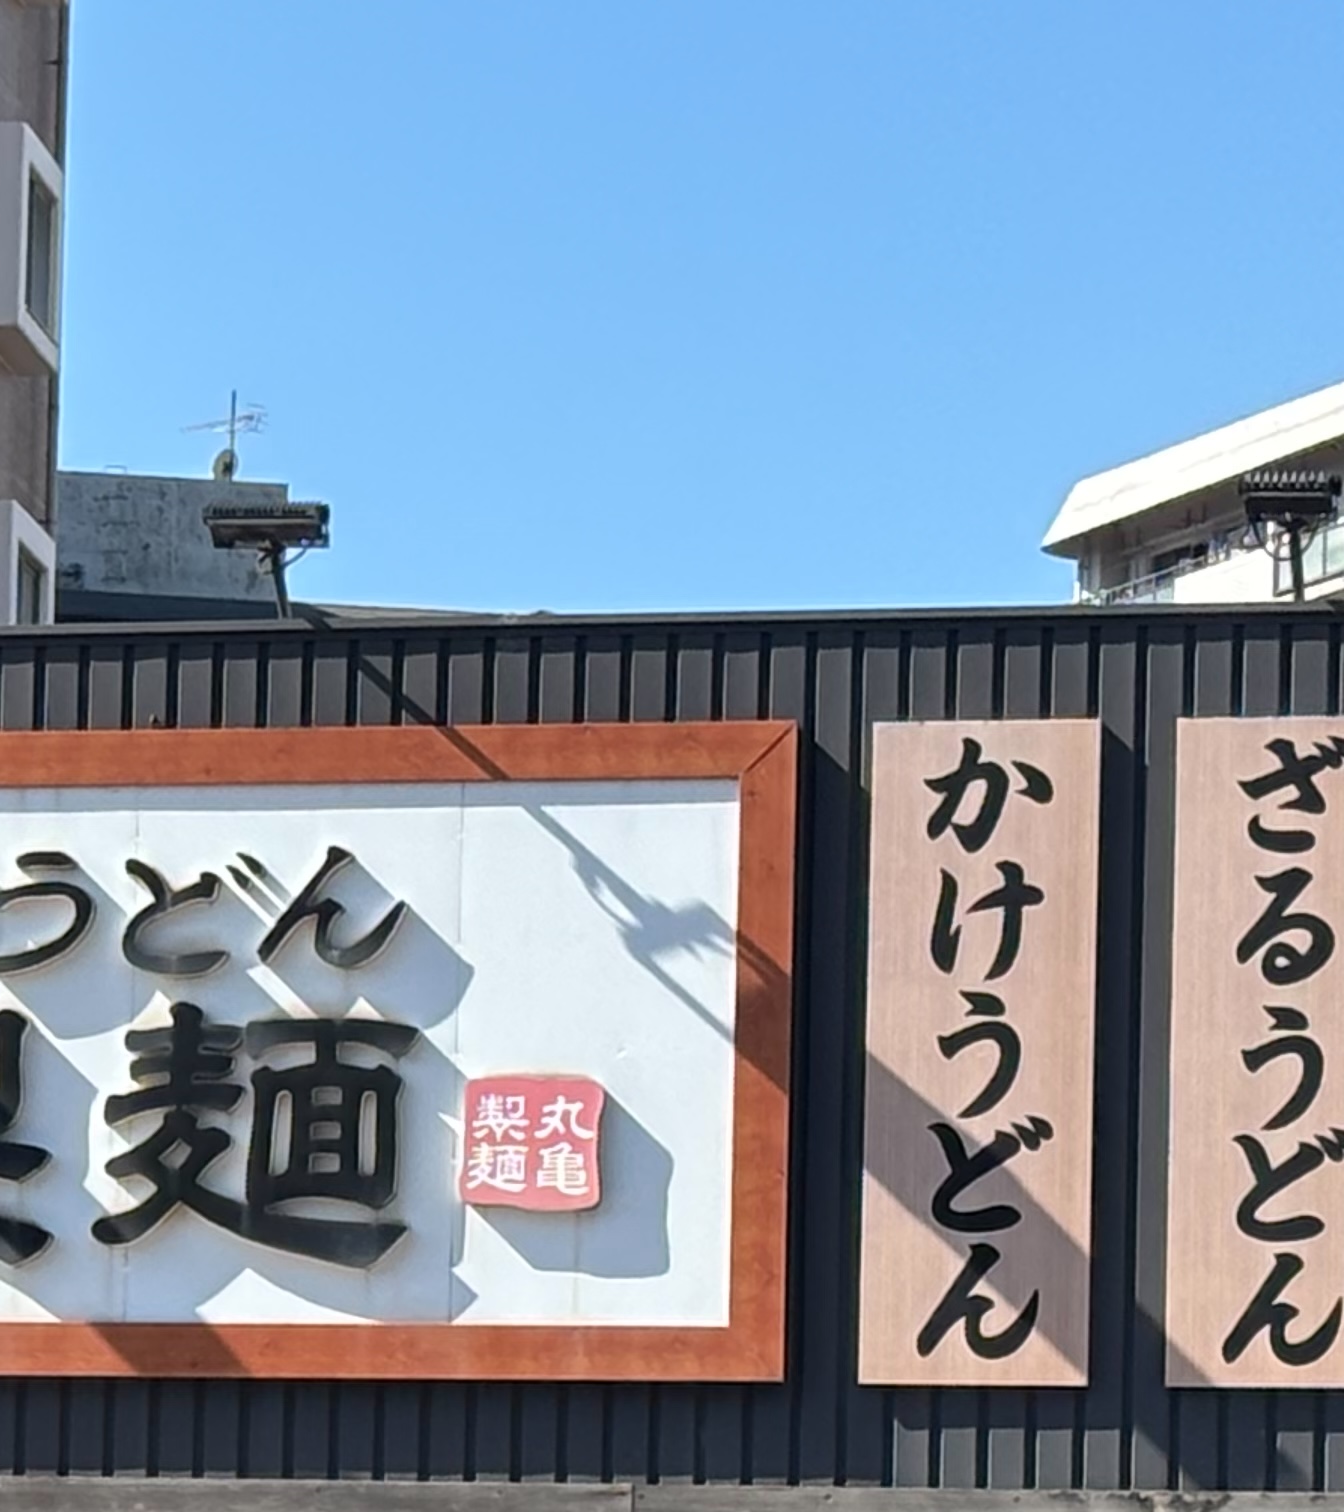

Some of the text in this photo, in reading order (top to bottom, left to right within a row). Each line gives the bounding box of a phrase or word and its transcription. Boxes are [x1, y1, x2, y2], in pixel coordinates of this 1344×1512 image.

[915, 736, 1055, 1360] かけうどん
[1220, 733, 1344, 1367] ざるうどん
